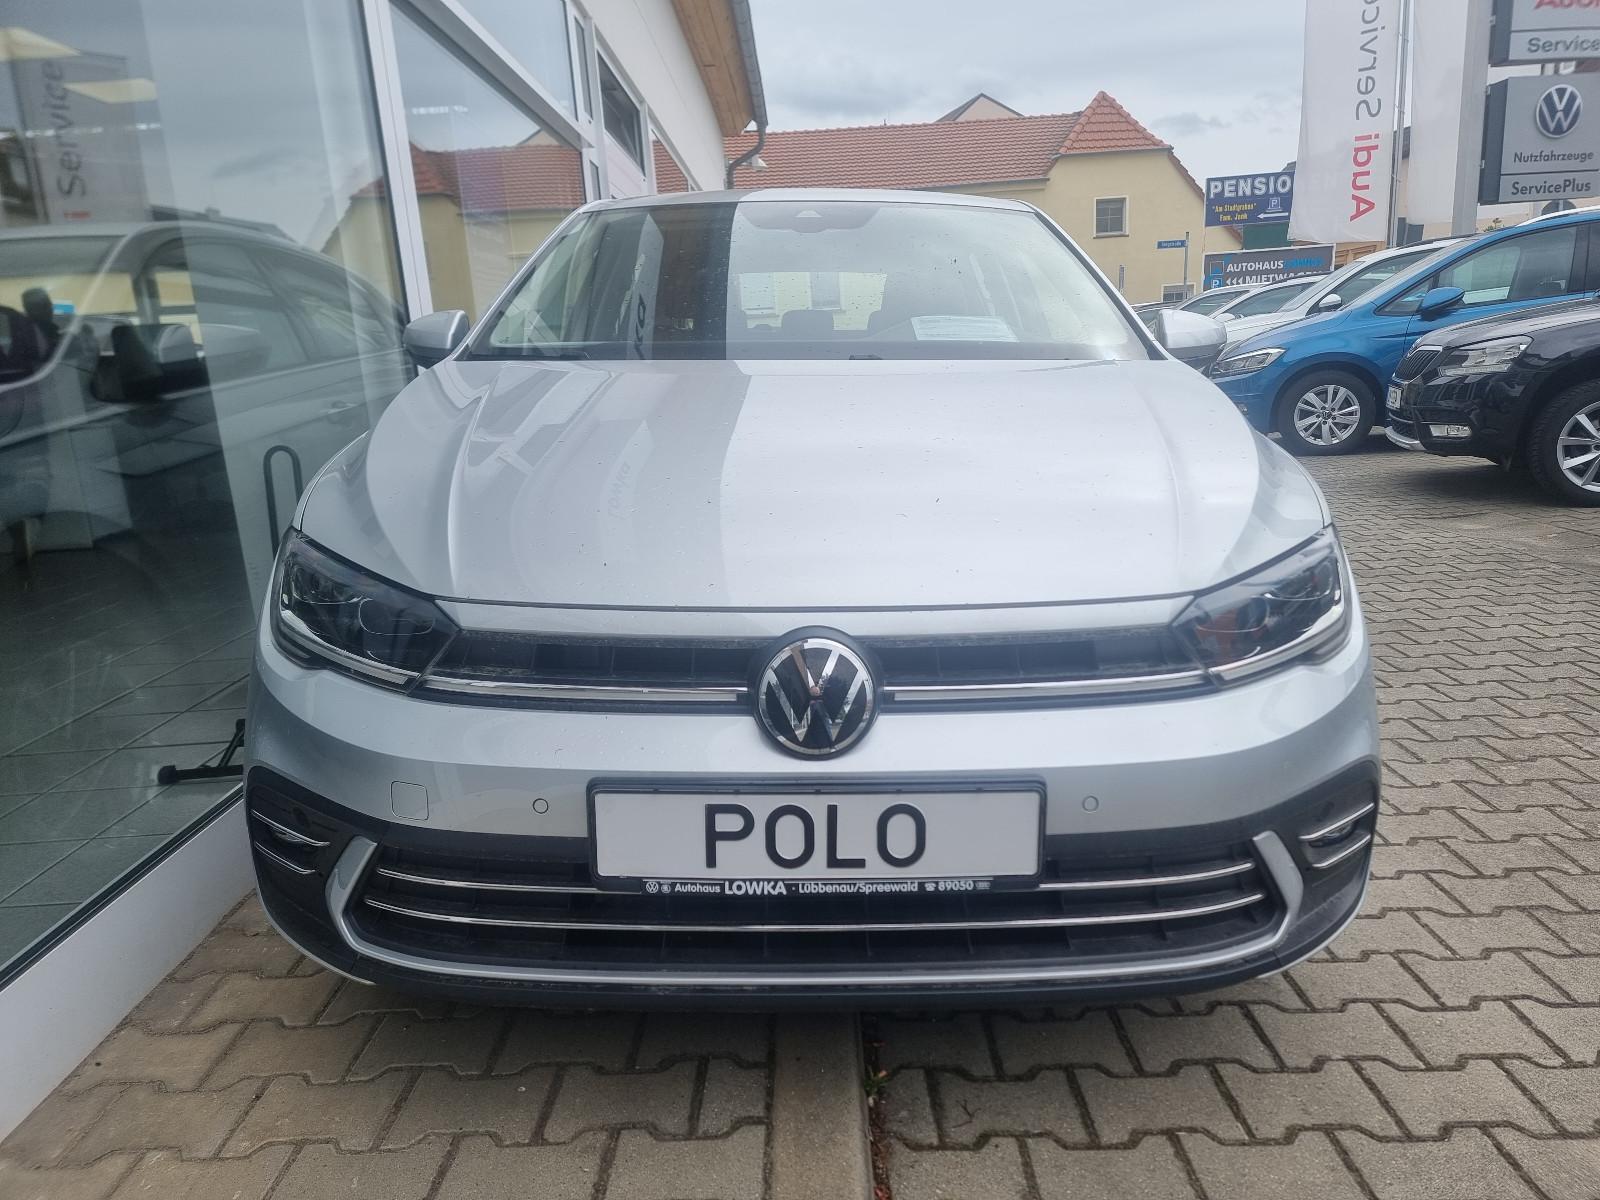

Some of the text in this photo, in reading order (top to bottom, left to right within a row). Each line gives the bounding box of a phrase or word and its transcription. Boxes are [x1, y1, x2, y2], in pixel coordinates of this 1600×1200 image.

[1527, 35, 1600, 53] Service
[1513, 150, 1594, 163] Nutzfahrzeuge
[1209, 174, 1292, 199] PENSIO
[1511, 178, 1591, 196] ServicePlus
[1226, 260, 1284, 273] AUTOHAUS
[704, 803, 926, 869] POLO
[674, 883, 721, 893] Autohaus
[724, 880, 787, 896] LOWKA
[798, 881, 919, 895] Lübbenau/Spreewald
[938, 880, 975, 892] 89050
